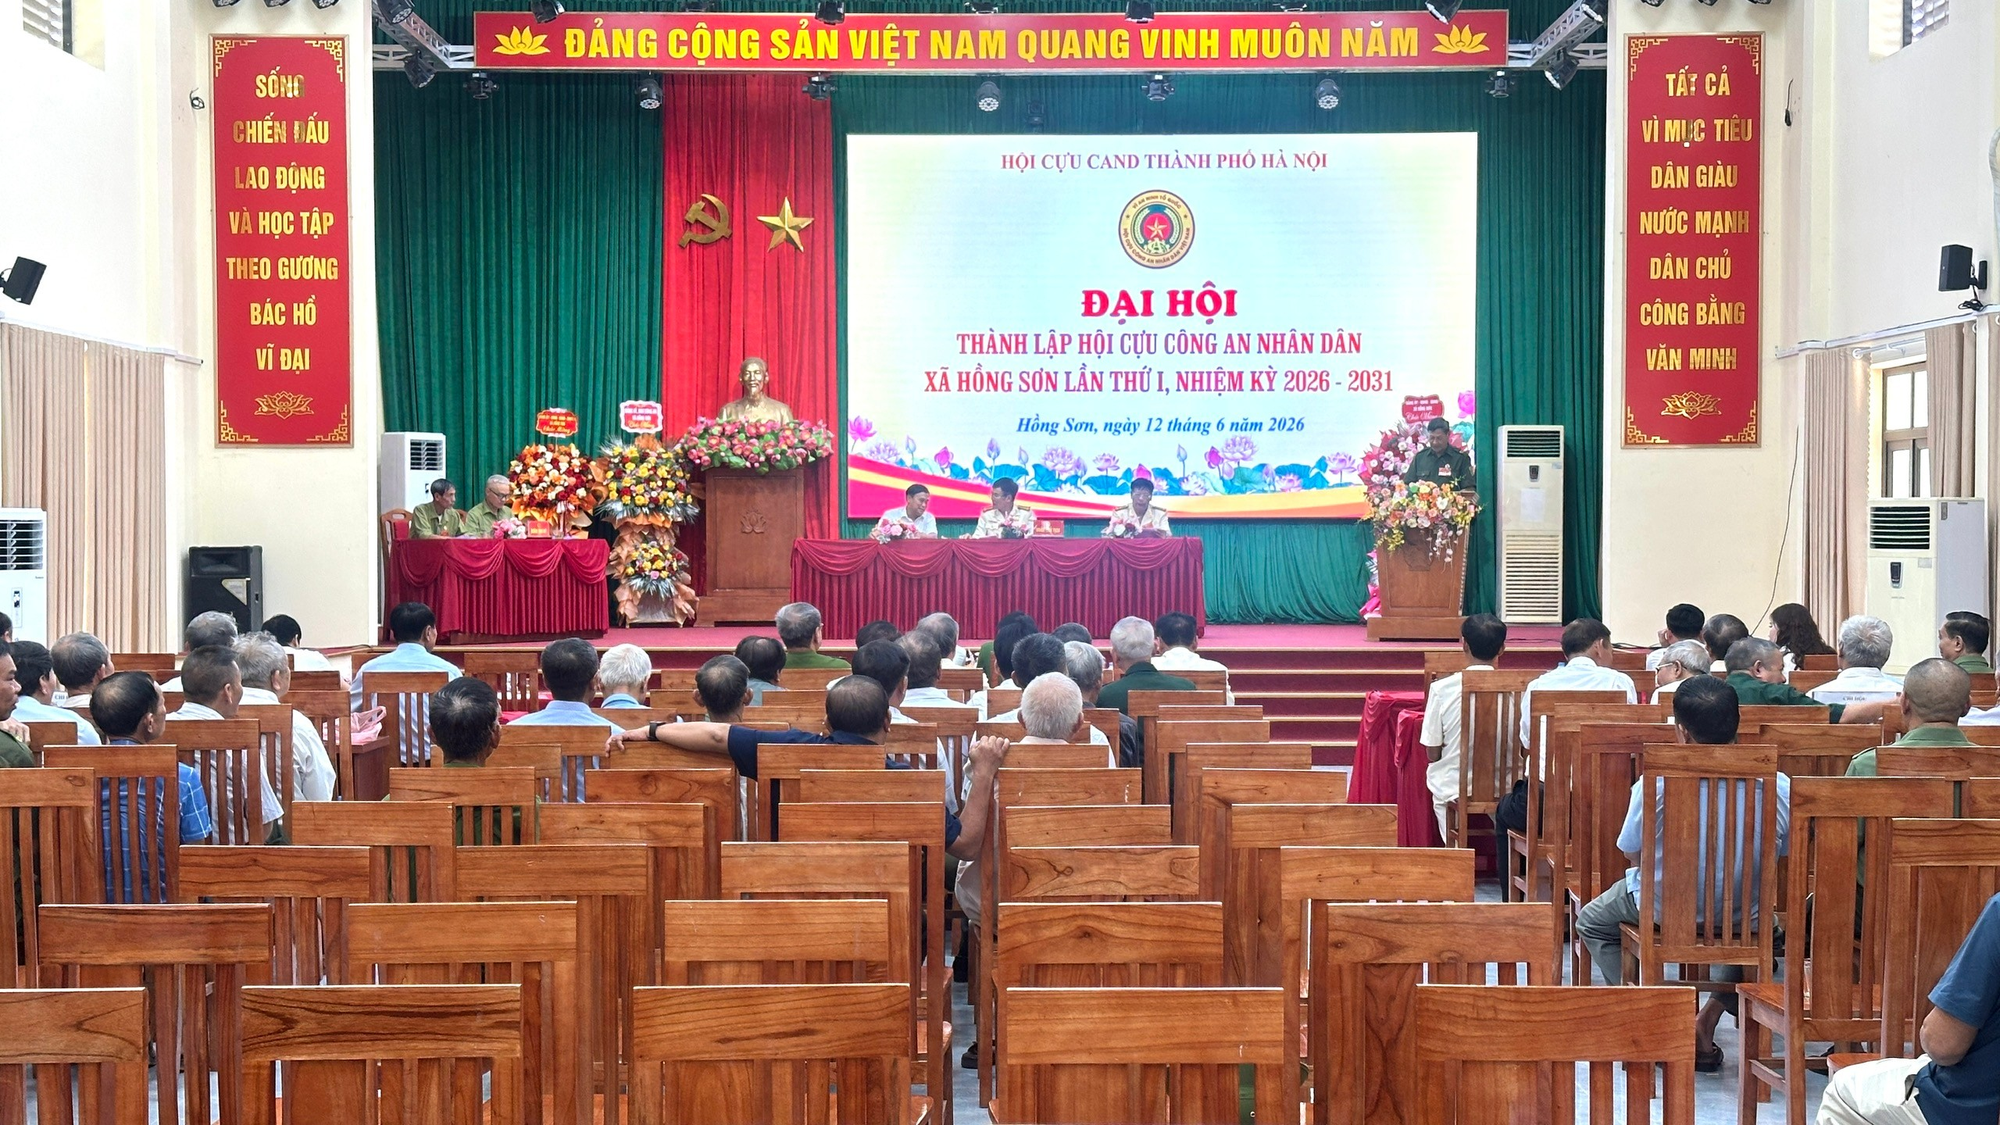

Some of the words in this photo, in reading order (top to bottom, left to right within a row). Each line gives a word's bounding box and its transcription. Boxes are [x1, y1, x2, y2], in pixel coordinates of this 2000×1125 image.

[564, 19, 659, 59] ĐẢNG
[667, 22, 761, 66] CỘNG
[769, 19, 839, 60] SẢN
[848, 23, 920, 67] VIỆT
[929, 29, 1007, 60] NAM
[1017, 28, 1130, 63] QUANG
[1139, 28, 1220, 59] VINH
[1229, 22, 1331, 59] MUÔN
[1341, 20, 1419, 58] NĂM
[255, 66, 306, 99] SỐNG
[1665, 64, 1698, 97] TẤT
[1704, 64, 1731, 97] CẢ
[233, 111, 287, 145] CHIẾN
[293, 111, 330, 145] ĐẤU
[1641, 114, 1659, 143] VÌ
[1664, 118, 1706, 149] MỤC
[1713, 114, 1753, 142] TIÊU
[1001, 152, 1035, 173] HỘI
[1041, 152, 1081, 173] CỰU
[1086, 154, 1140, 170] CAND
[1144, 149, 1212, 170] THÀNH
[1216, 148, 1256, 169] PHỐ
[1261, 149, 1289, 168] HÀ
[1293, 151, 1328, 172] NỘI
[1651, 161, 1689, 189] DÂN
[1695, 161, 1738, 189] GIÀU
[234, 166, 270, 190] LAO
[275, 161, 326, 195] ĐỘNG
[228, 207, 253, 235] VÀ
[258, 210, 295, 240] HỌC
[299, 206, 335, 240] TẬP
[1639, 206, 1689, 235] NƯỚC
[1695, 210, 1749, 239] MẠNH
[225, 256, 272, 281] THEO
[277, 254, 339, 281] GƯƠNG
[1649, 252, 1689, 280] DÂN
[1695, 247, 1732, 280] CHỦ
[249, 297, 287, 326] BÁC
[292, 294, 317, 326] HỒ
[1080, 289, 1155, 326] ĐẠI
[1166, 280, 1238, 325] HỘI
[1640, 297, 1689, 326] CÔNG
[1695, 293, 1745, 326] BẰNG
[255, 343, 275, 371] VĨ
[279, 347, 310, 375] ĐẠI
[956, 327, 1028, 355] THÀNH
[1033, 329, 1073, 359] LẬP
[1077, 329, 1114, 359] HỘI
[1119, 331, 1158, 359] CỰU
[1163, 328, 1218, 355] CÔNG
[1223, 333, 1252, 355] AN
[1256, 328, 1315, 354] NHÂN
[1320, 328, 1362, 354] DÂN
[1646, 343, 1682, 371] VĂN
[1689, 347, 1737, 371] MINH
[924, 366, 952, 392] XÃ
[956, 363, 1014, 393] HỒNG
[1018, 367, 1059, 393] SƠN
[1064, 363, 1104, 393] LẦN
[1109, 365, 1153, 393] THỨ
[1156, 371, 1170, 396] I,
[1175, 366, 1245, 397] NHIỆM
[1249, 364, 1278, 392] KỲ
[1283, 370, 1330, 393] 2026
[1347, 369, 1393, 392] 2031
[1017, 412, 1059, 436] Hồng
[1063, 416, 1098, 436] Sơn,
[1103, 417, 1141, 436] ngày
[1146, 417, 1163, 432] 12
[1167, 415, 1211, 436] tháng
[1216, 417, 1225, 432] 6
[1229, 416, 1263, 432] năm
[1268, 417, 1305, 432] 2026
